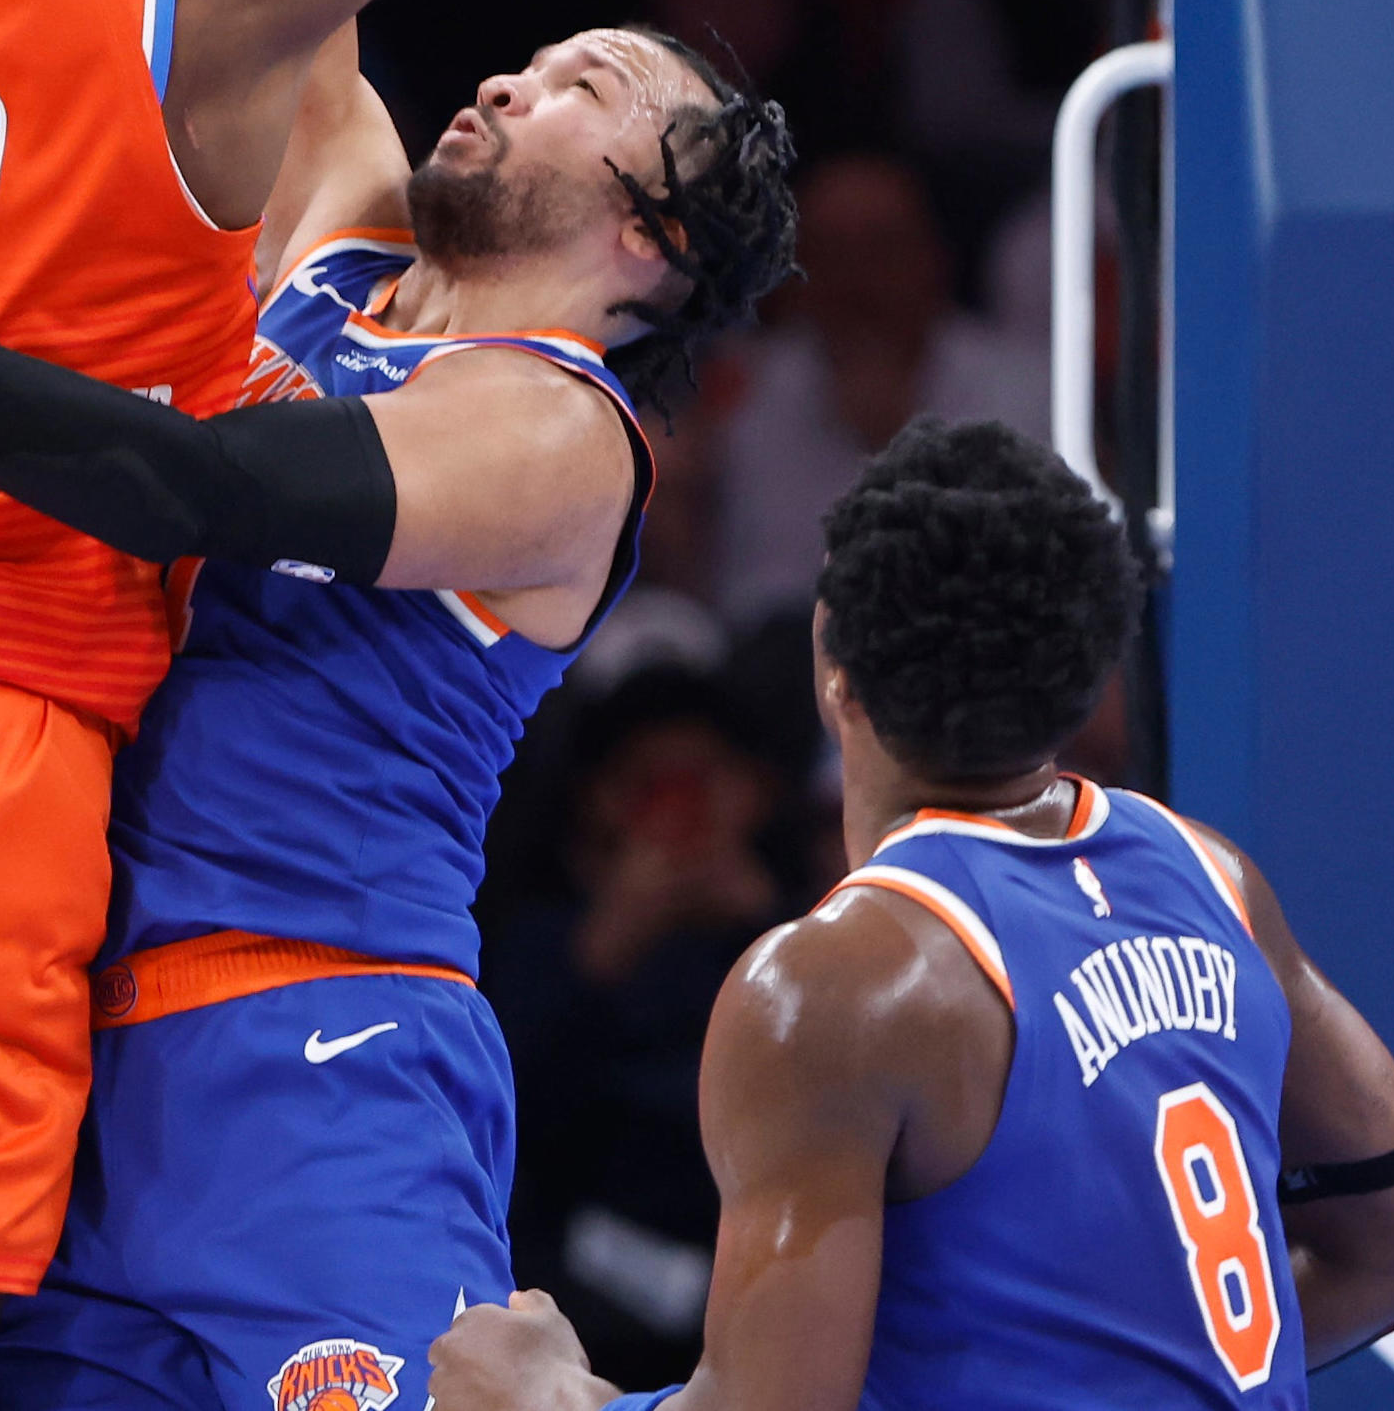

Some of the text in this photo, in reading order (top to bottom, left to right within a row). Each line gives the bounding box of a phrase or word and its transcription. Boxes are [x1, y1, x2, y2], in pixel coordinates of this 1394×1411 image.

[1053, 935, 1237, 1088] ANUNOBY
[1154, 1082, 1281, 1392] 8
[278, 1349, 394, 1411] KNICKS
